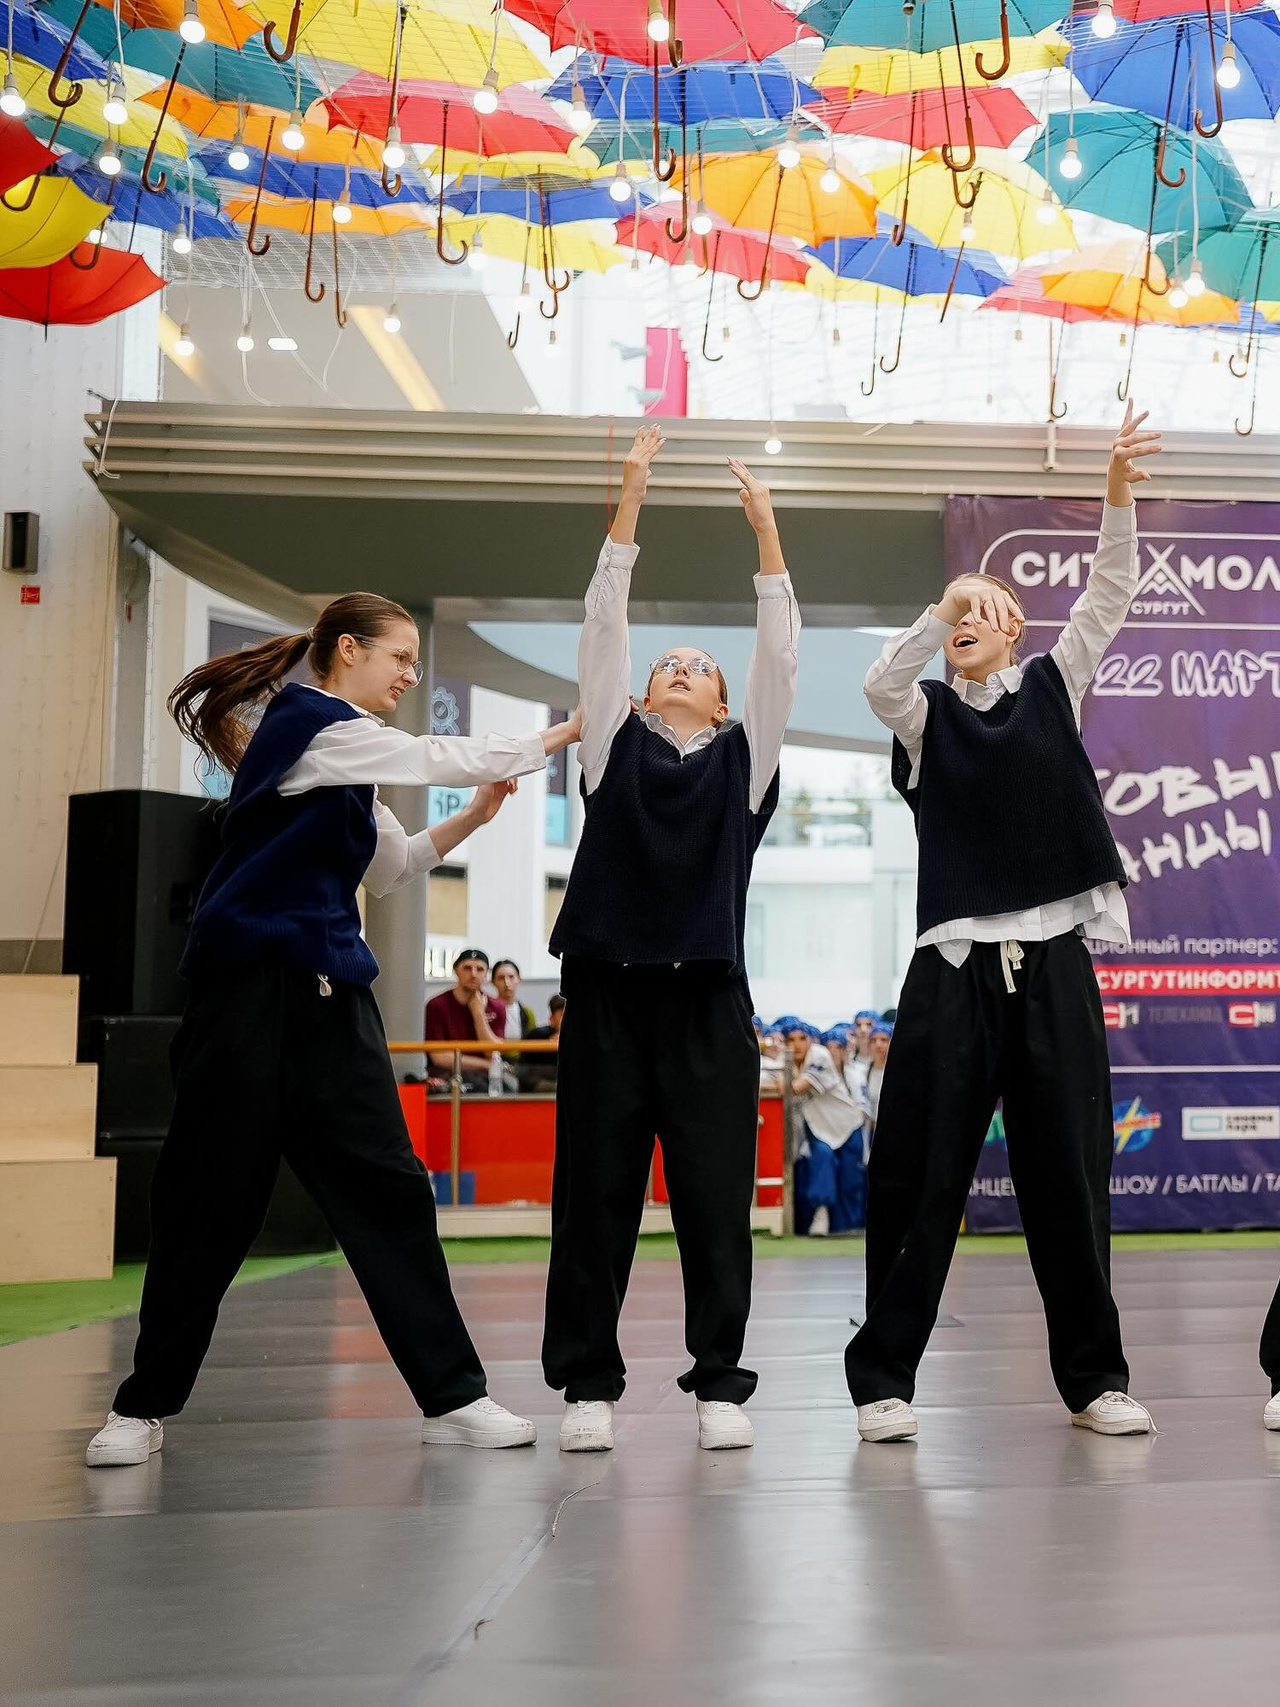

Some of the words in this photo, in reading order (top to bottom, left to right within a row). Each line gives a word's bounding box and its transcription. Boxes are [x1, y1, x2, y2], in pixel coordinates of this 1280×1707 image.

[1011, 550, 1141, 588] СИ
[1131, 600, 1191, 616] СУРГУТ
[1184, 937, 1279, 958] партнер:
[1109, 1174, 1158, 1195] ШОУ
[1176, 1173, 1249, 1194] БАТТЛЫ
